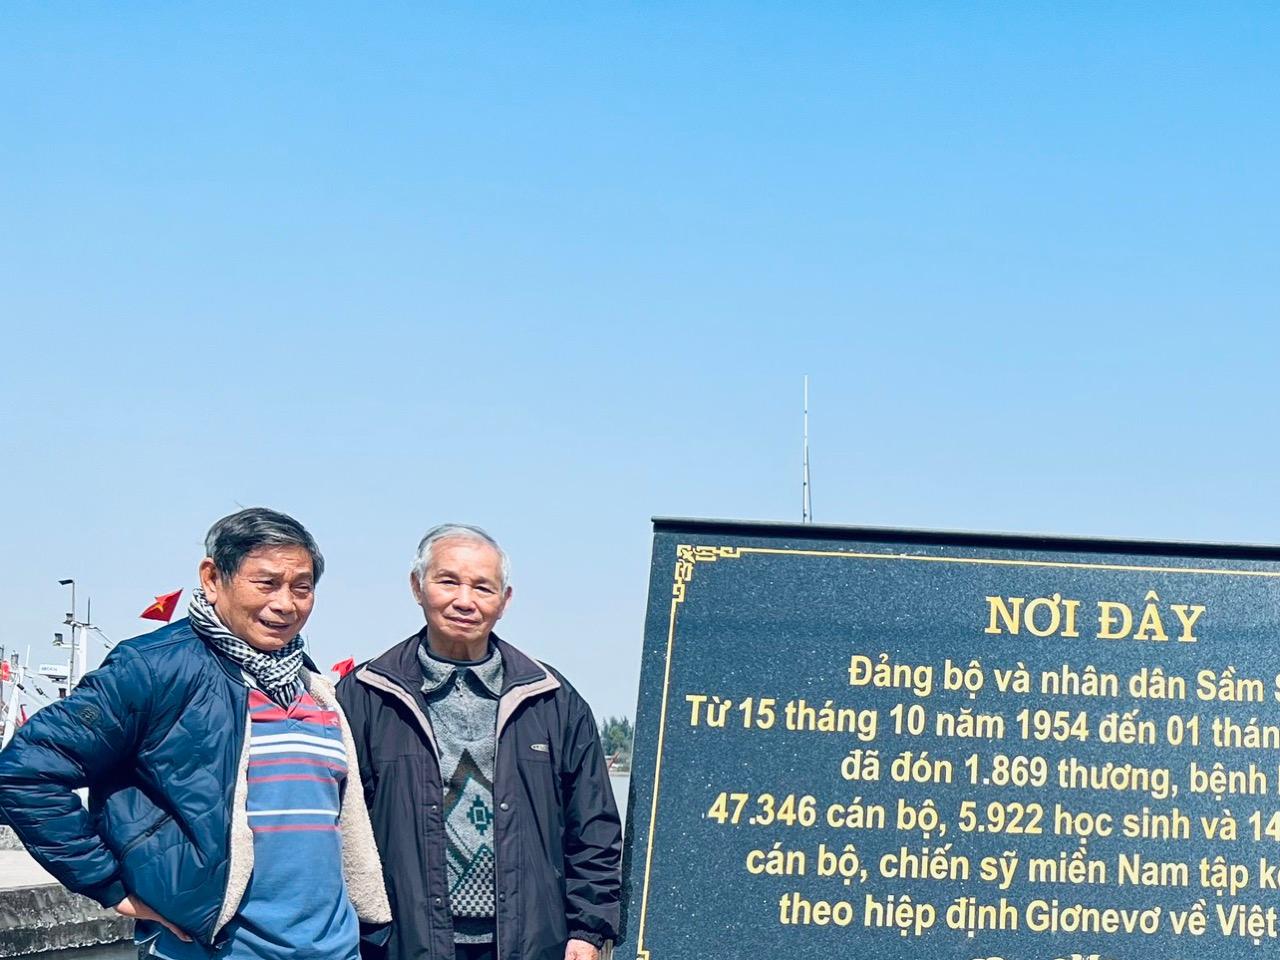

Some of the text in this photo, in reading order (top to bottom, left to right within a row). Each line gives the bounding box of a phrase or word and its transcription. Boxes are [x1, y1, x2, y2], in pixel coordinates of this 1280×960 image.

[985, 591, 1205, 643] NƠI ĐÂY
[849, 653, 933, 697] Đảng
[944, 660, 985, 699] bộ
[994, 662, 1031, 693] và
[1042, 665, 1119, 698] nhân
[1130, 667, 1187, 699] dân
[1197, 666, 1265, 702] Sầm
[687, 694, 732, 728] Từ
[741, 697, 776, 730] 15
[785, 699, 878, 742] tháng
[892, 704, 926, 735] 10
[937, 708, 1005, 738] năm
[1018, 709, 1089, 741] 1954
[1100, 709, 1157, 744] đến
[1167, 715, 1200, 746] 01
[842, 750, 880, 780] đã
[891, 751, 953, 784] đón
[966, 754, 1048, 786] 1.869
[1058, 759, 1178, 799] thương,
[1190, 761, 1268, 800] bệnh
[708, 792, 817, 827] 47.346
[827, 797, 886, 829] cán
[897, 798, 948, 839] bộ,
[959, 800, 1045, 835] 5.922
[1055, 804, 1113, 844] học
[1123, 807, 1191, 839] sinh
[1201, 810, 1238, 841] và
[746, 843, 806, 875] cán
[817, 844, 869, 885] bộ,
[879, 843, 970, 880] chiến
[980, 851, 1019, 890] sỹ
[1029, 846, 1107, 885] miền
[1118, 853, 1189, 886] Nam
[1200, 856, 1249, 897] tập
[779, 892, 854, 926] theo
[864, 895, 936, 937] hiệp
[946, 897, 1019, 937] định
[1026, 899, 1161, 933] Giơnevơ
[1171, 899, 1207, 936] về
[1217, 904, 1276, 945] Việt
